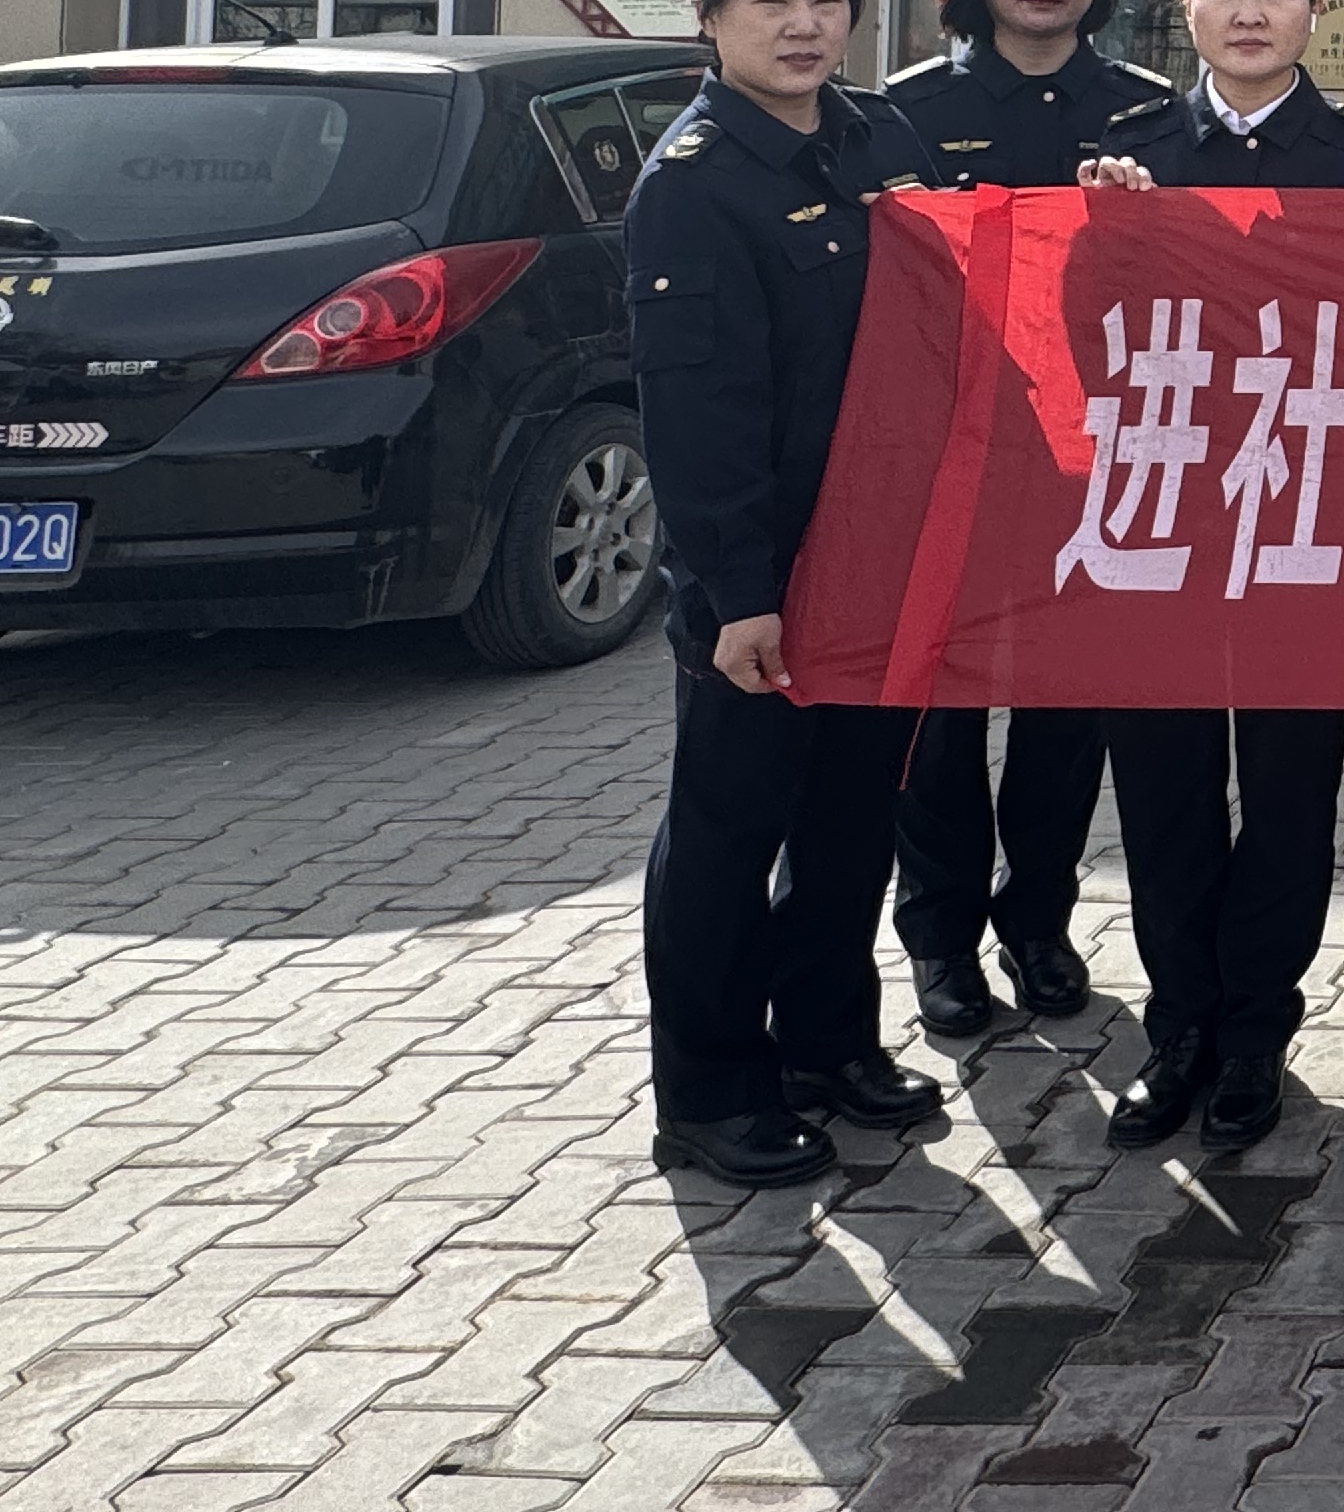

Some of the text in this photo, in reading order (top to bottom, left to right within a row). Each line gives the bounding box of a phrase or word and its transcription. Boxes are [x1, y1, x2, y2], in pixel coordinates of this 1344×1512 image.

[86, 360, 159, 376] 东风日产
[0, 424, 35, 448] 距
